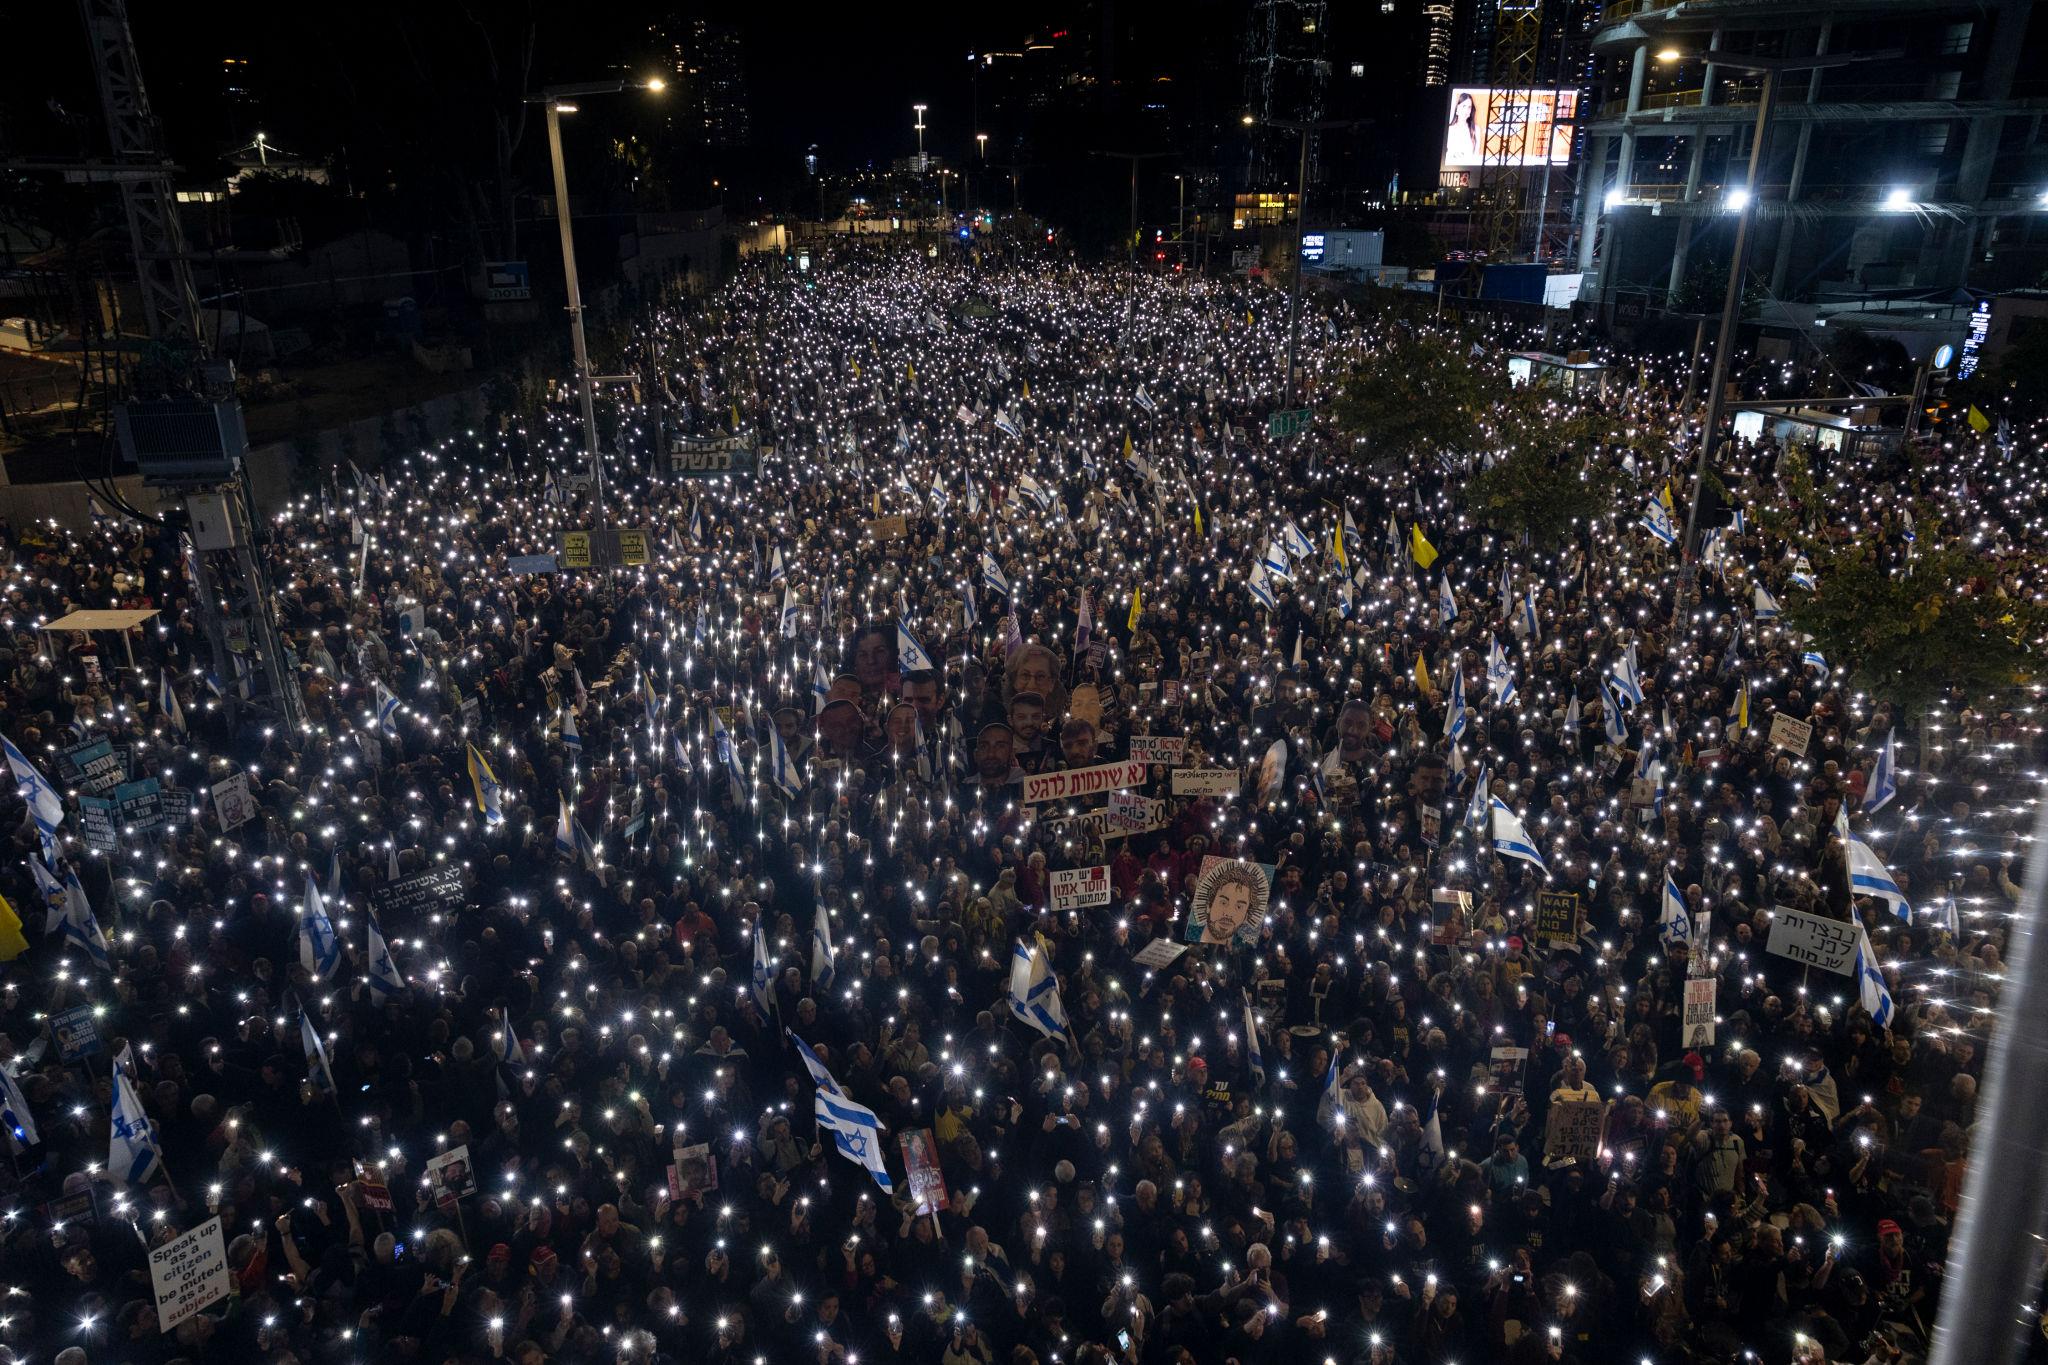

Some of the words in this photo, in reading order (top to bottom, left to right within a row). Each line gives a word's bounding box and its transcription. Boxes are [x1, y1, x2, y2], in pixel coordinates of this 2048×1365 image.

[671, 451, 732, 471] לנשק
[567, 548, 587, 556] אשם
[1149, 738, 1158, 749] לא
[1160, 738, 1183, 750] ישראל
[1070, 766, 1123, 795] שוכחות
[1127, 763, 1146, 784] לא
[1029, 773, 1065, 800] לרגע
[1120, 806, 1146, 820] כולם
[443, 865, 460, 880] לא
[1060, 871, 1074, 882] לנו
[1079, 869, 1090, 880] יש
[432, 879, 463, 896] ארצי
[1053, 881, 1078, 898] אמון
[1081, 879, 1107, 892] חוסר
[445, 892, 465, 905] את
[1073, 892, 1107, 906] מתמשך
[1542, 897, 1570, 908] WAR
[1542, 909, 1568, 920] HAS
[1542, 919, 1560, 930] NO
[1535, 929, 1577, 944] WINNERS
[1809, 934, 1852, 956] לפני
[1688, 992, 1696, 1004] TO
[1696, 992, 1713, 1003] BLAME
[1688, 1003, 1698, 1014] FOR
[1215, 1081, 1229, 1091] עד
[1207, 1089, 1230, 1102] מתי?
[153, 1234, 197, 1263] Speak
[200, 1223, 217, 1237] up
[170, 1253, 187, 1265] as
[191, 1244, 199, 1254] a
[164, 1249, 212, 1281] citizen
[182, 1267, 197, 1281] or
[159, 1290, 177, 1305] be
[180, 1260, 224, 1293] muted
[179, 1292, 195, 1305] as
[198, 1283, 206, 1292] a
[168, 1287, 220, 1323] subject
